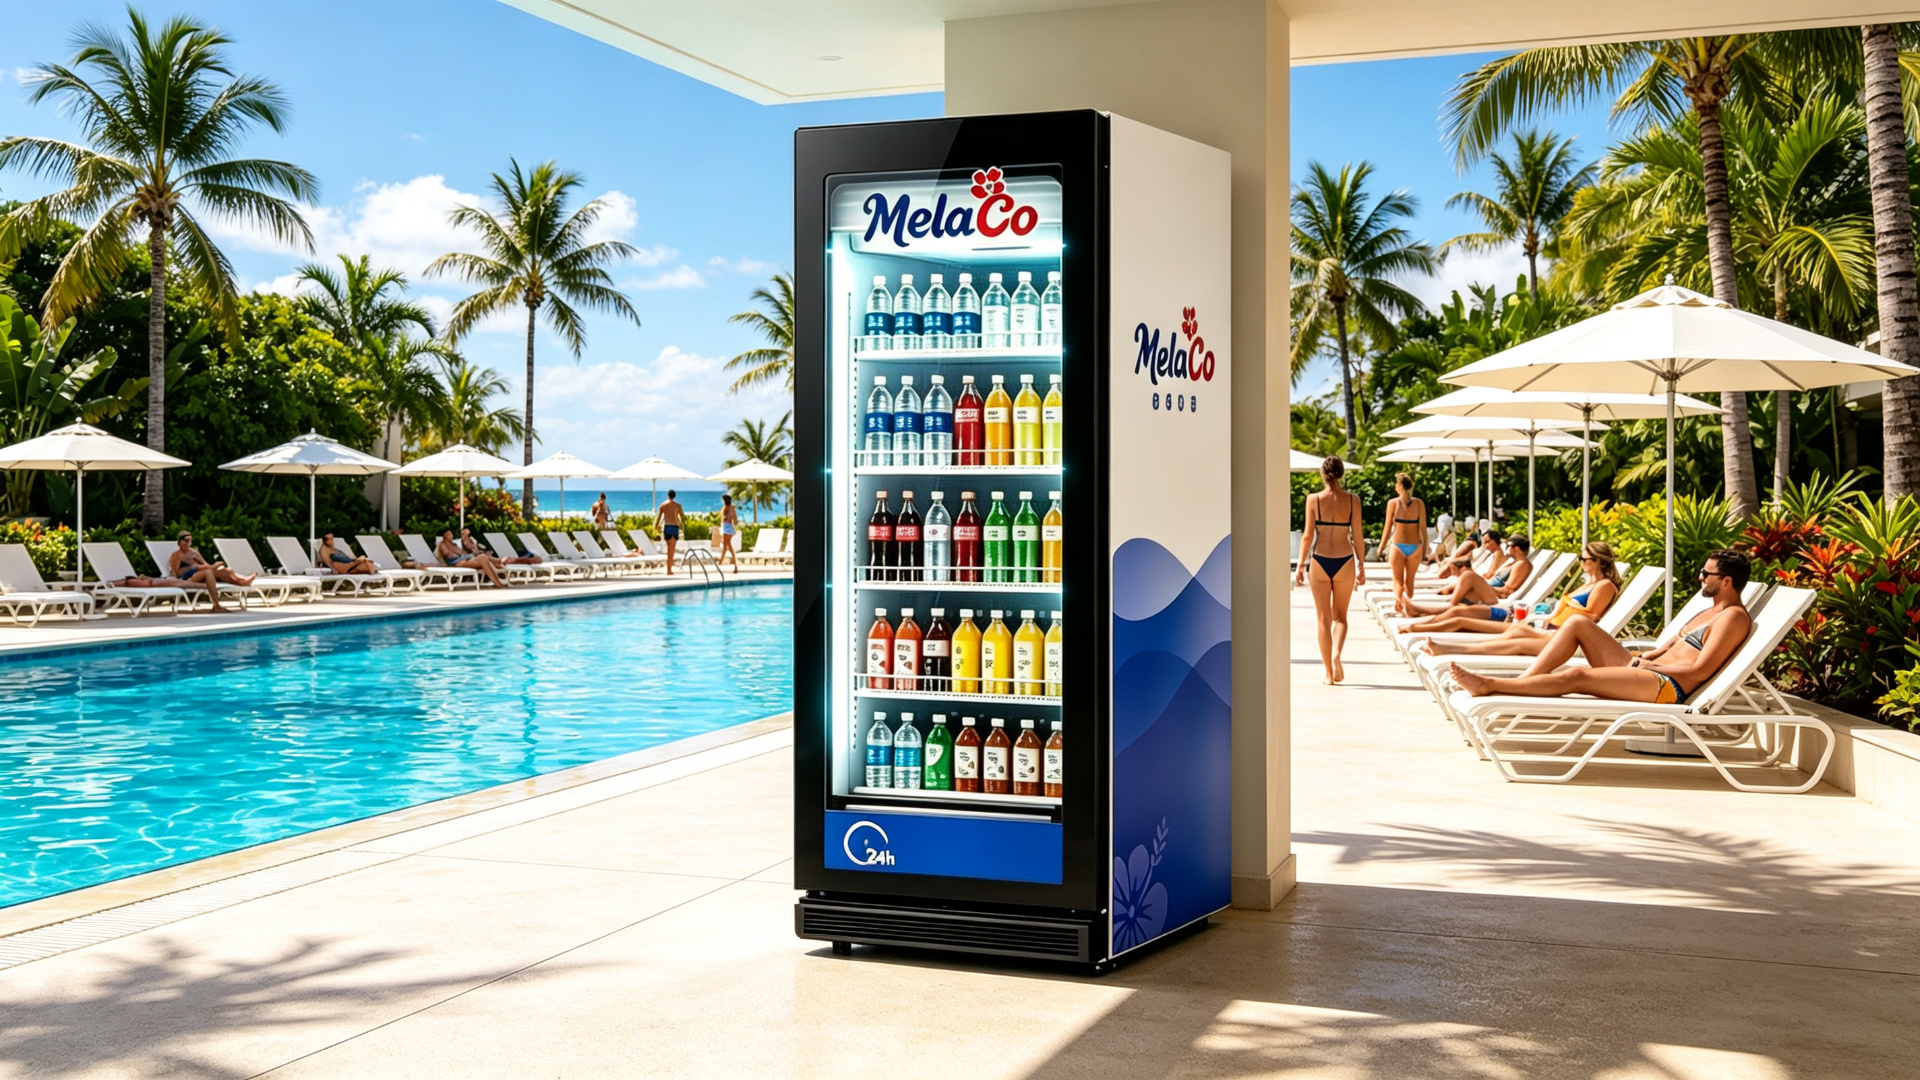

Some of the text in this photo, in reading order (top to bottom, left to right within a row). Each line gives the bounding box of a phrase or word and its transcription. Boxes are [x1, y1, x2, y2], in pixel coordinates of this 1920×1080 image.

[863, 192, 1038, 247] MelaCo
[1134, 322, 1215, 385] MelaCo
[866, 847, 895, 866] 24h
